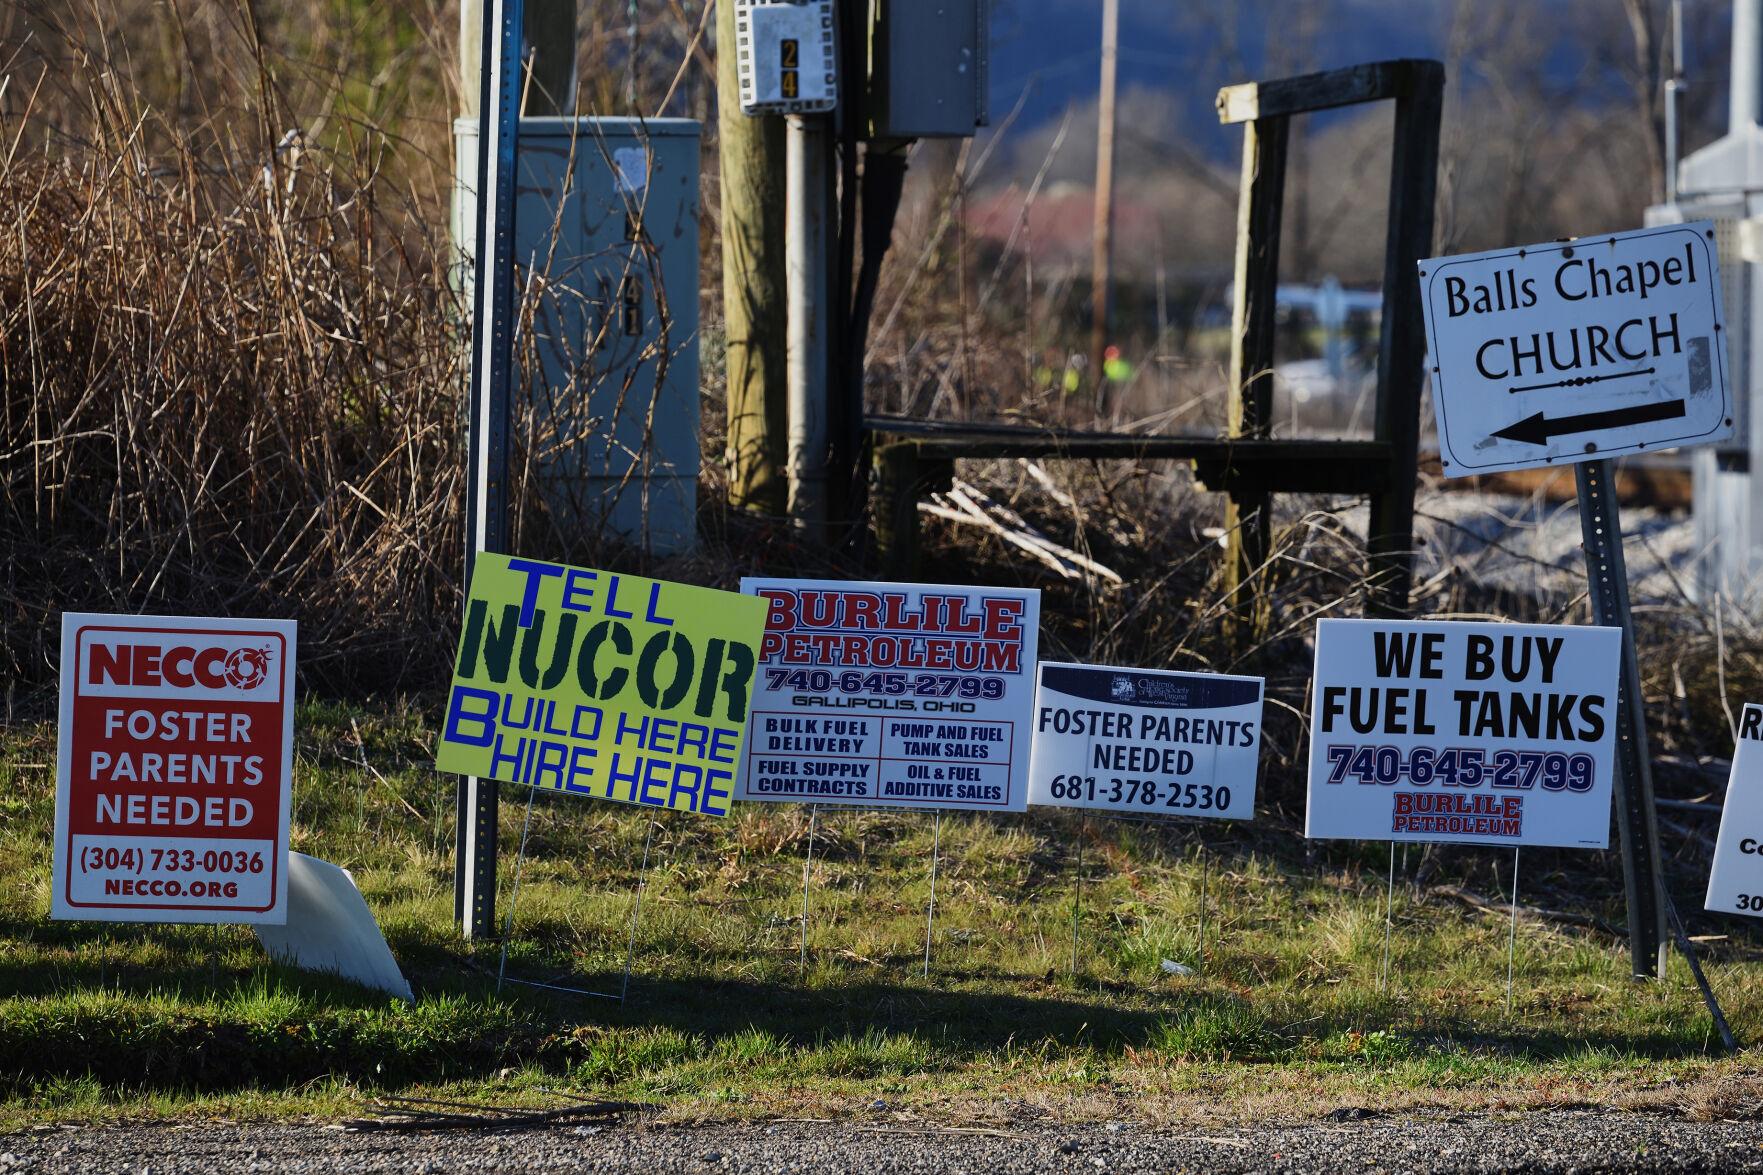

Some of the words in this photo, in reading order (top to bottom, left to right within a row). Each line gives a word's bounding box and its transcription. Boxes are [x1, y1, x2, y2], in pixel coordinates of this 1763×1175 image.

[1445, 269, 1537, 317] Balls
[1554, 242, 1697, 301] Chapel
[1475, 313, 1682, 380] CHURCH
[508, 559, 675, 629] TELL
[758, 589, 1026, 641] BURLILE
[89, 643, 272, 690] NECCO
[457, 599, 755, 723] NUCOR
[758, 633, 1021, 674] PETROLEUM
[1373, 631, 1445, 680] WE
[1465, 634, 1564, 684] BUY
[766, 668, 1006, 700] 740-645-2799
[792, 695, 917, 712] GALLIPOLIS,
[923, 701, 976, 713] OHIO
[1322, 686, 1435, 735] FUEL
[1454, 690, 1605, 743] TANKS
[105, 709, 252, 743] FOSTER
[444, 685, 604, 748] BUILD
[615, 712, 738, 764] HERE
[766, 718, 819, 736] BULK
[824, 720, 869, 737] FUEL
[891, 724, 934, 739] PUMP
[937, 725, 967, 740] AND
[970, 727, 1003, 742] FUEL
[1040, 707, 1133, 739] FOSTER
[1141, 715, 1254, 748] PARENTS
[768, 736, 864, 753] DELIVERY
[904, 741, 941, 756] TANK
[945, 743, 989, 758] SALES
[1094, 744, 1193, 775] NEEDED
[90, 751, 264, 785] PARENTS
[489, 734, 598, 793] HIRE
[606, 753, 733, 817] HERE
[758, 760, 798, 775] FUEL
[803, 762, 870, 778] SUPPLY
[907, 765, 931, 779] OIL
[934, 767, 944, 780] &
[948, 767, 981, 781] FUEL
[1327, 745, 1594, 793] 740-645-2799
[758, 778, 867, 795] CONTRACTS
[885, 785, 954, 798] ADDITIVE
[957, 786, 1001, 800] SALES
[1050, 774, 1230, 810] 681-378-2530
[96, 794, 254, 827] NEEDED
[1393, 792, 1523, 819] BURLILE
[1392, 815, 1522, 836] PETROLEUM
[80, 846, 143, 875] (304)
[150, 848, 264, 874] 733-0036
[105, 879, 238, 897] NECCO.ORG
